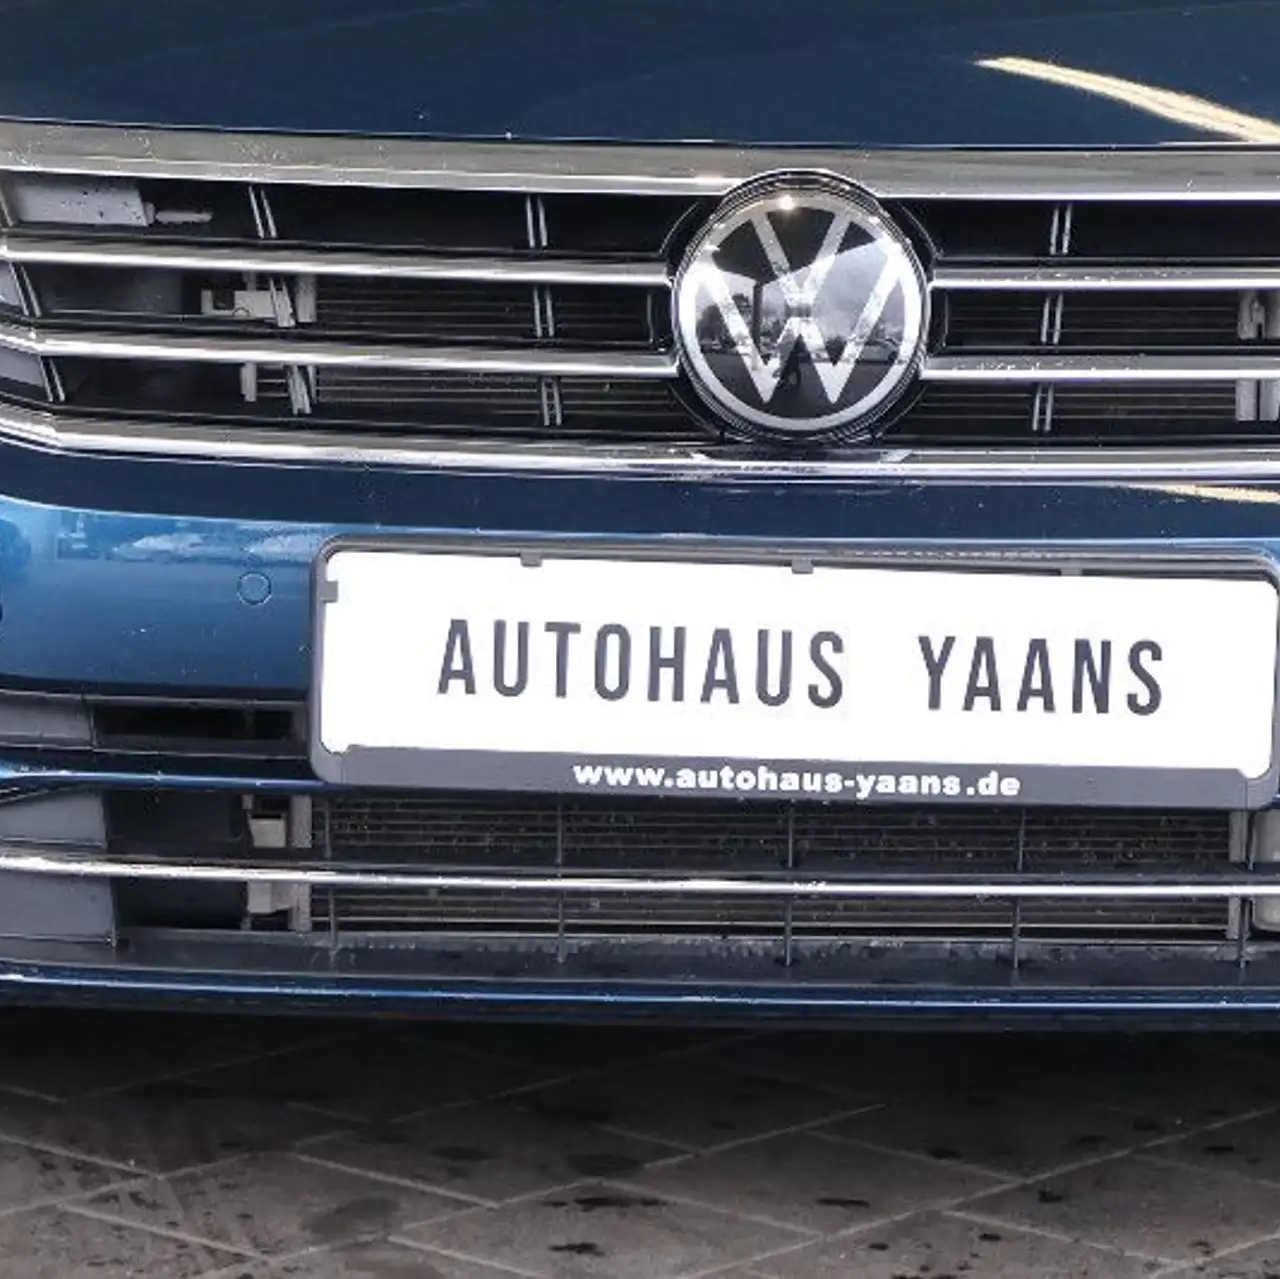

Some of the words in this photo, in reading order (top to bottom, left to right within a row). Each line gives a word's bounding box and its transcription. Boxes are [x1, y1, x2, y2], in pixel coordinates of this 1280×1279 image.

[436, 617, 845, 709] AUTOHAUS
[918, 634, 1164, 717] YAANS
[572, 760, 1021, 800] www.autohaus-yaans.de
